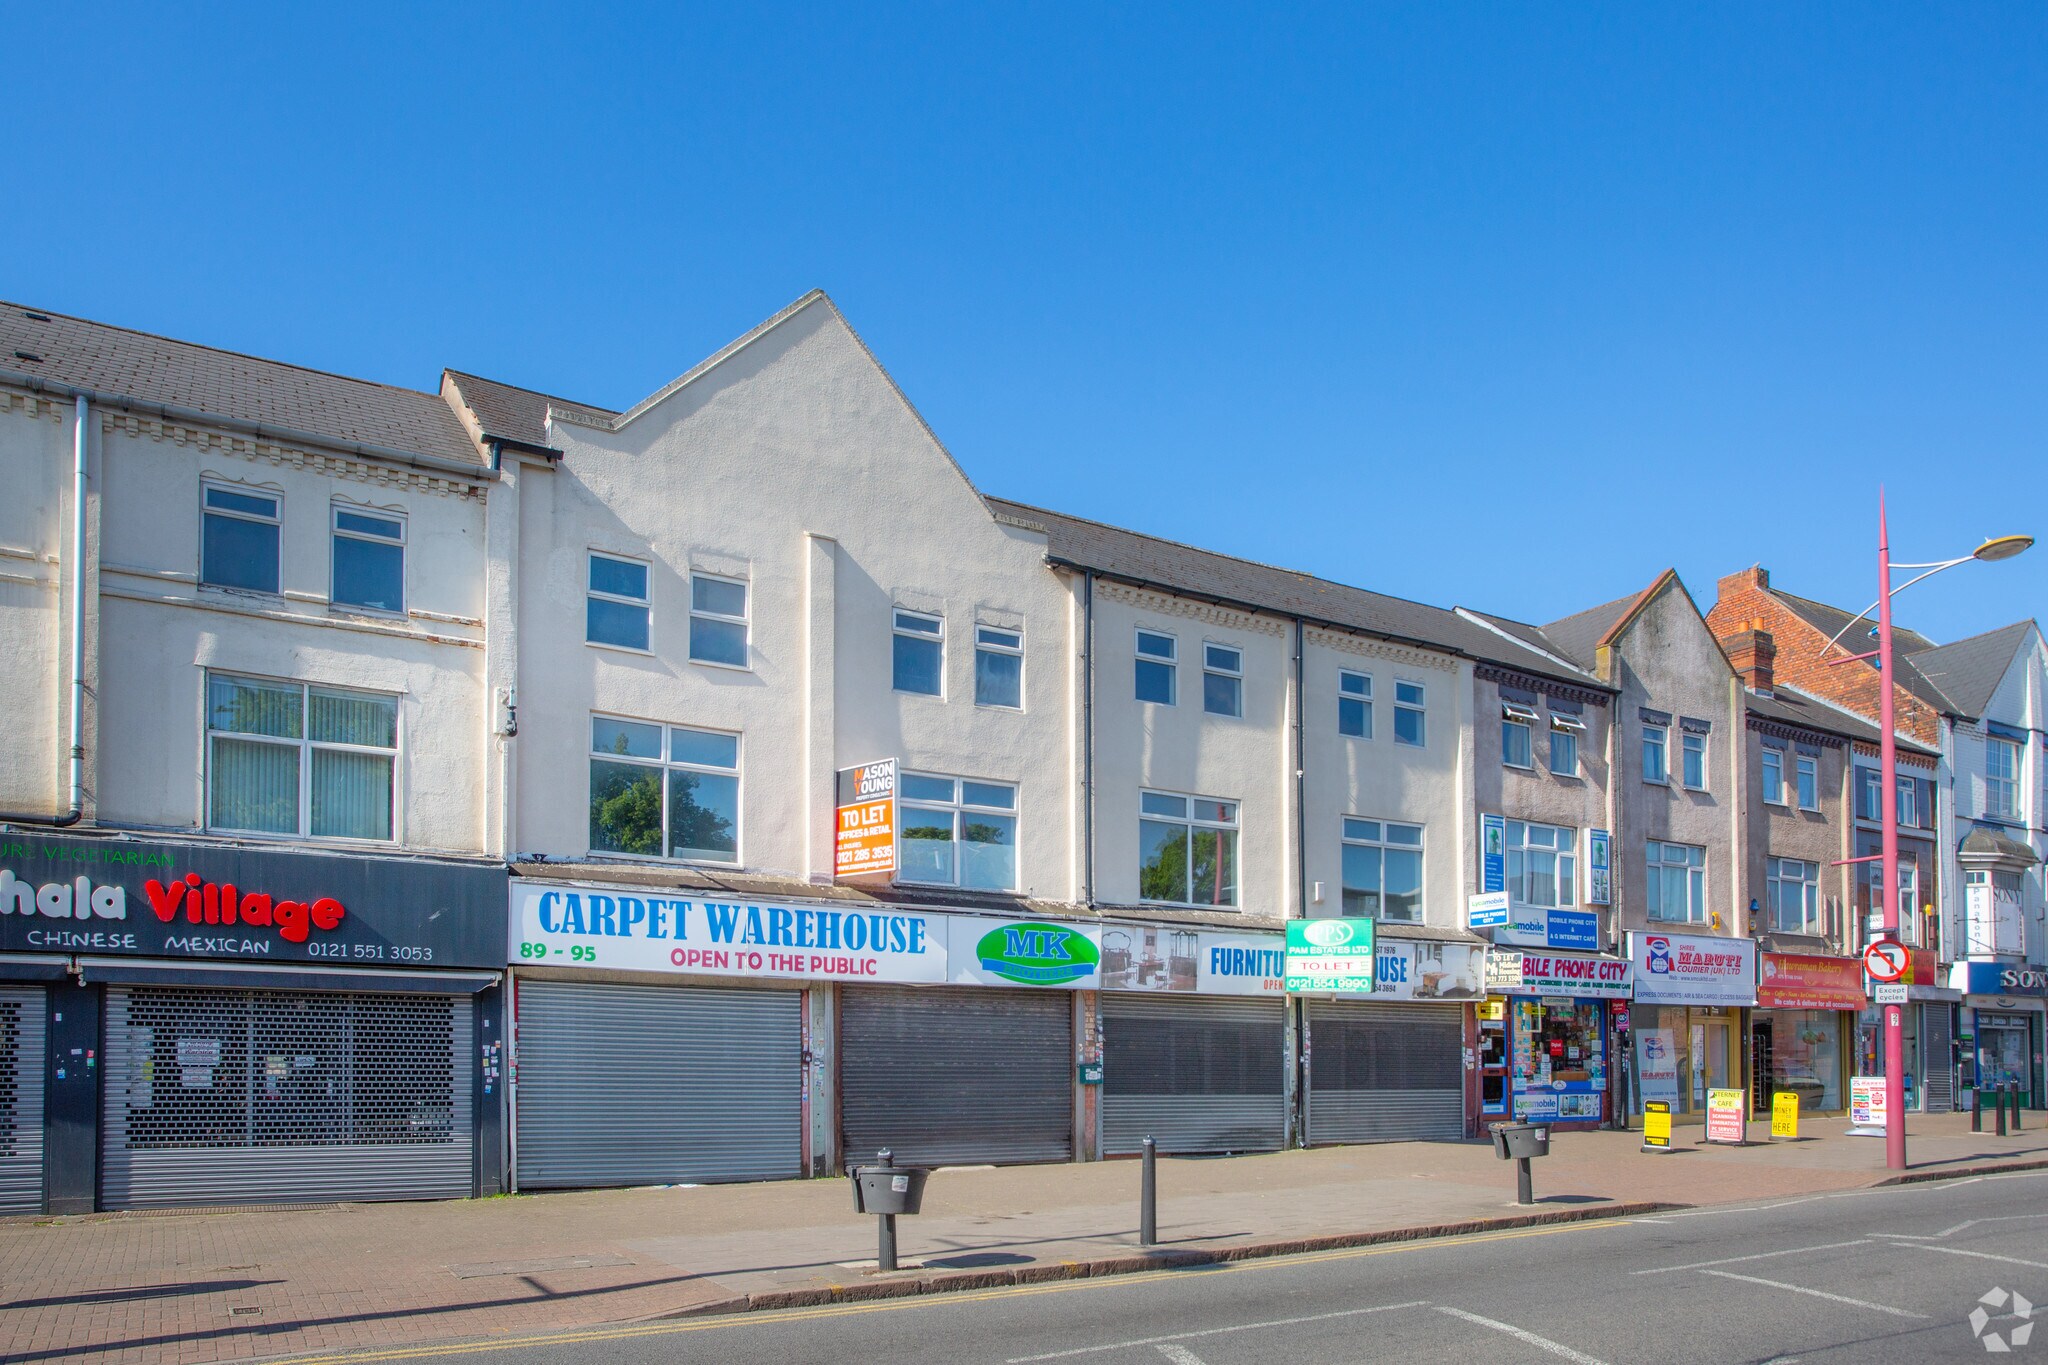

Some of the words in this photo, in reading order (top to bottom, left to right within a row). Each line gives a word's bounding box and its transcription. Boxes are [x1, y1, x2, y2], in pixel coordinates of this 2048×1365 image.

[854, 761, 893, 782] MASON
[854, 776, 893, 796] YOUNG
[842, 810, 859, 828] TO
[862, 805, 886, 825] LET
[838, 829, 863, 841] OFFICES
[864, 827, 868, 836] &
[870, 825, 891, 836] RETAIL
[44, 846, 175, 868] VEGETARIAN
[0, 869, 127, 920] hala
[145, 872, 345, 943] Village
[1472, 898, 1505, 907] Lycamobile
[538, 891, 692, 940] CARPET
[704, 903, 926, 954] WAREHOUSE
[27, 930, 138, 949] CHINESE
[165, 936, 270, 954] MEXICAN
[309, 942, 348, 957] 0121
[354, 944, 384, 959] 551
[391, 946, 433, 961] 3053
[520, 942, 547, 958] 89
[571, 945, 596, 962] 95
[1003, 929, 1071, 959] MK
[1289, 946, 1308, 954] PAM
[1310, 946, 1350, 954] ESTATES
[1352, 945, 1369, 953] LTD
[670, 947, 728, 969] OPEN
[735, 951, 763, 970] TO
[768, 953, 804, 972] THE
[810, 956, 877, 976] PUBLIC
[1211, 947, 1284, 978] FURNITU
[1300, 962, 1320, 970] TO
[1324, 962, 1354, 970] LET
[1523, 957, 1551, 976] BILE
[1555, 959, 1596, 979] PHONE
[1599, 961, 1627, 981] CITY
[1677, 965, 1709, 973] COURIER
[1678, 952, 1742, 967] MARUTI
[1818, 962, 1842, 976] Bakery
[1264, 980, 1283, 990] OPEN
[1288, 979, 1312, 988] 0121
[1313, 979, 1335, 988] 554
[1337, 979, 1369, 988] 9990
[1515, 1099, 1556, 1109] Lycamobile
[1773, 1122, 1790, 1132] HERE
